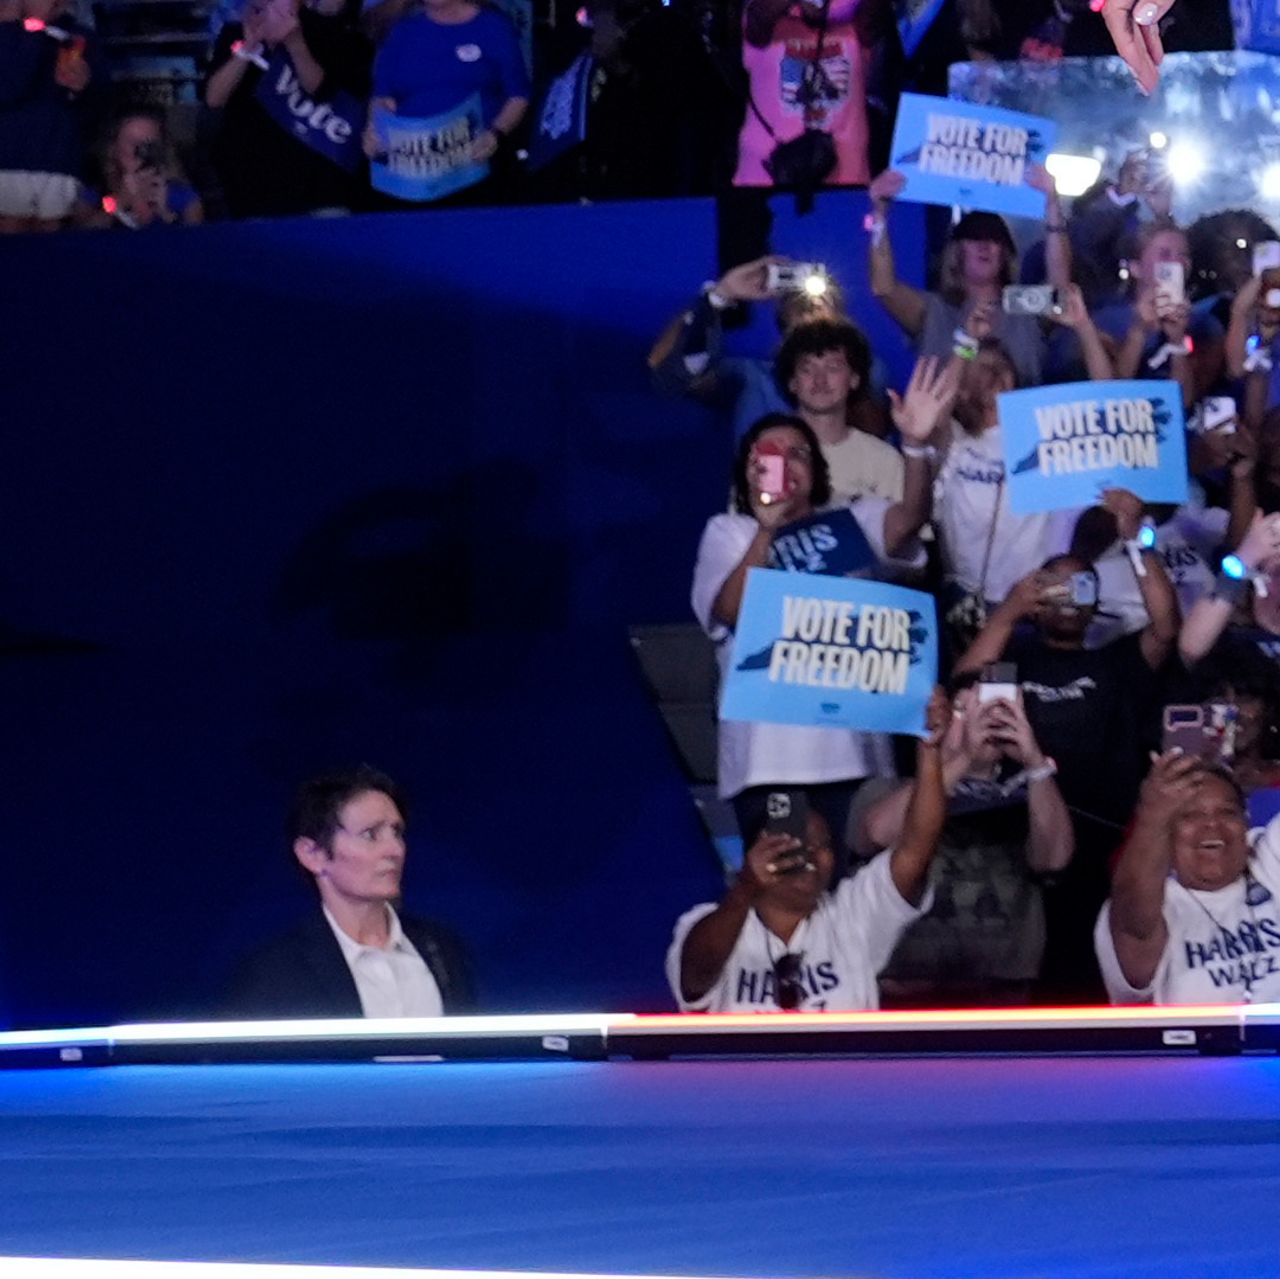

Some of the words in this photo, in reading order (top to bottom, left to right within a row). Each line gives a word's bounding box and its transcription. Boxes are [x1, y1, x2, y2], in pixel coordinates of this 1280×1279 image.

[1034, 400, 1104, 440] VOTE
[1103, 398, 1156, 435] FOR
[1037, 432, 1160, 478] FREEDOM
[782, 595, 853, 645] VOTE
[855, 603, 912, 652] FOR
[768, 639, 912, 695] FREEDOM
[737, 961, 840, 1004] HAIS
